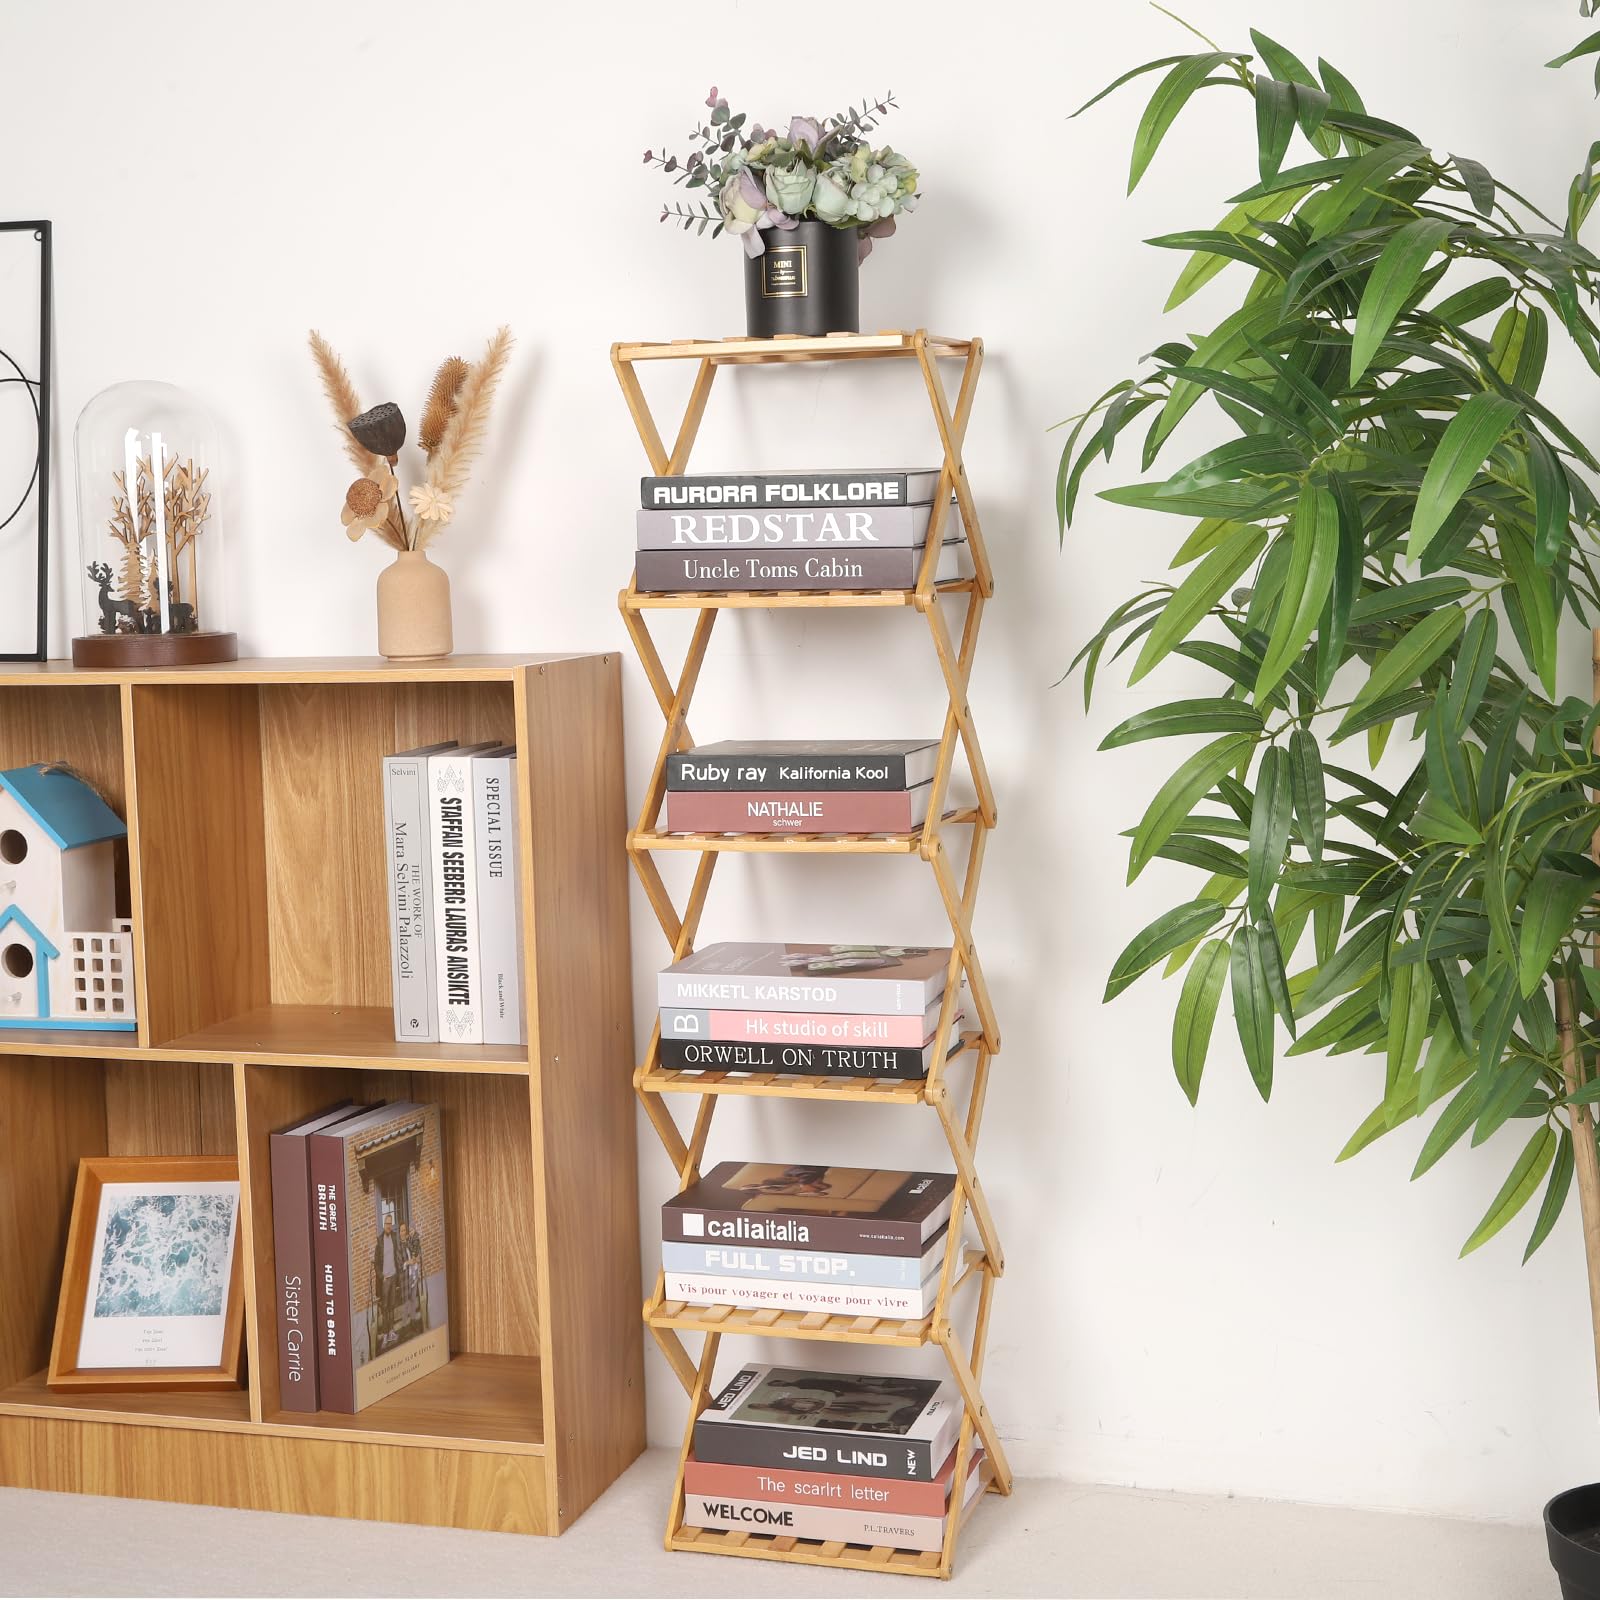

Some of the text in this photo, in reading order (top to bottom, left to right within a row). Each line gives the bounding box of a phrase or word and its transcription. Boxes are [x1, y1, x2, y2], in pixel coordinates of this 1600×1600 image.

[773, 260, 793, 269] MINI
[653, 481, 899, 504] AURORA FOLKLORE
[671, 512, 879, 544] REDSTAR
[683, 557, 863, 579] Uncle Toms Cabin
[391, 767, 417, 777] Selvini
[680, 763, 767, 783] Ruby ray
[779, 766, 889, 780] Kalifornia Kool
[747, 801, 824, 817] NATHALIE
[486, 777, 503, 878] SPECIAL ISSUE
[772, 817, 803, 827] schwer
[395, 822, 414, 979] Mara Selvini Palazzoli
[411, 864, 423, 938] THE WORK OF
[439, 797, 470, 1006] STAFFAN SEEBERG LAURAS ANSIKTE
[677, 983, 837, 1002] MIKKETL KARSTOD
[673, 1014, 699, 1033] B
[746, 1018, 889, 1038] Hk studio of skill
[684, 1044, 898, 1070] ORWELL ON TRUTH
[317, 1184, 328, 1231] BRITISH
[328, 1184, 338, 1232] THE GREAT
[707, 1218, 810, 1243] caliaitalia
[705, 1250, 856, 1277] FULL STOP.
[678, 1283, 909, 1308] Vis pour voyager et voyage pour vivre
[324, 1264, 336, 1356] HOW TO BAKE
[285, 1275, 304, 1383] Sister Carrie
[717, 1374, 752, 1408] JED LIND
[783, 1445, 888, 1467] JED LIND
[906, 1449, 917, 1475] NEW
[757, 1476, 890, 1502] The scarlrt letter
[703, 1502, 794, 1527] WELCOME
[863, 1524, 915, 1537] P.L.TRAVERS
